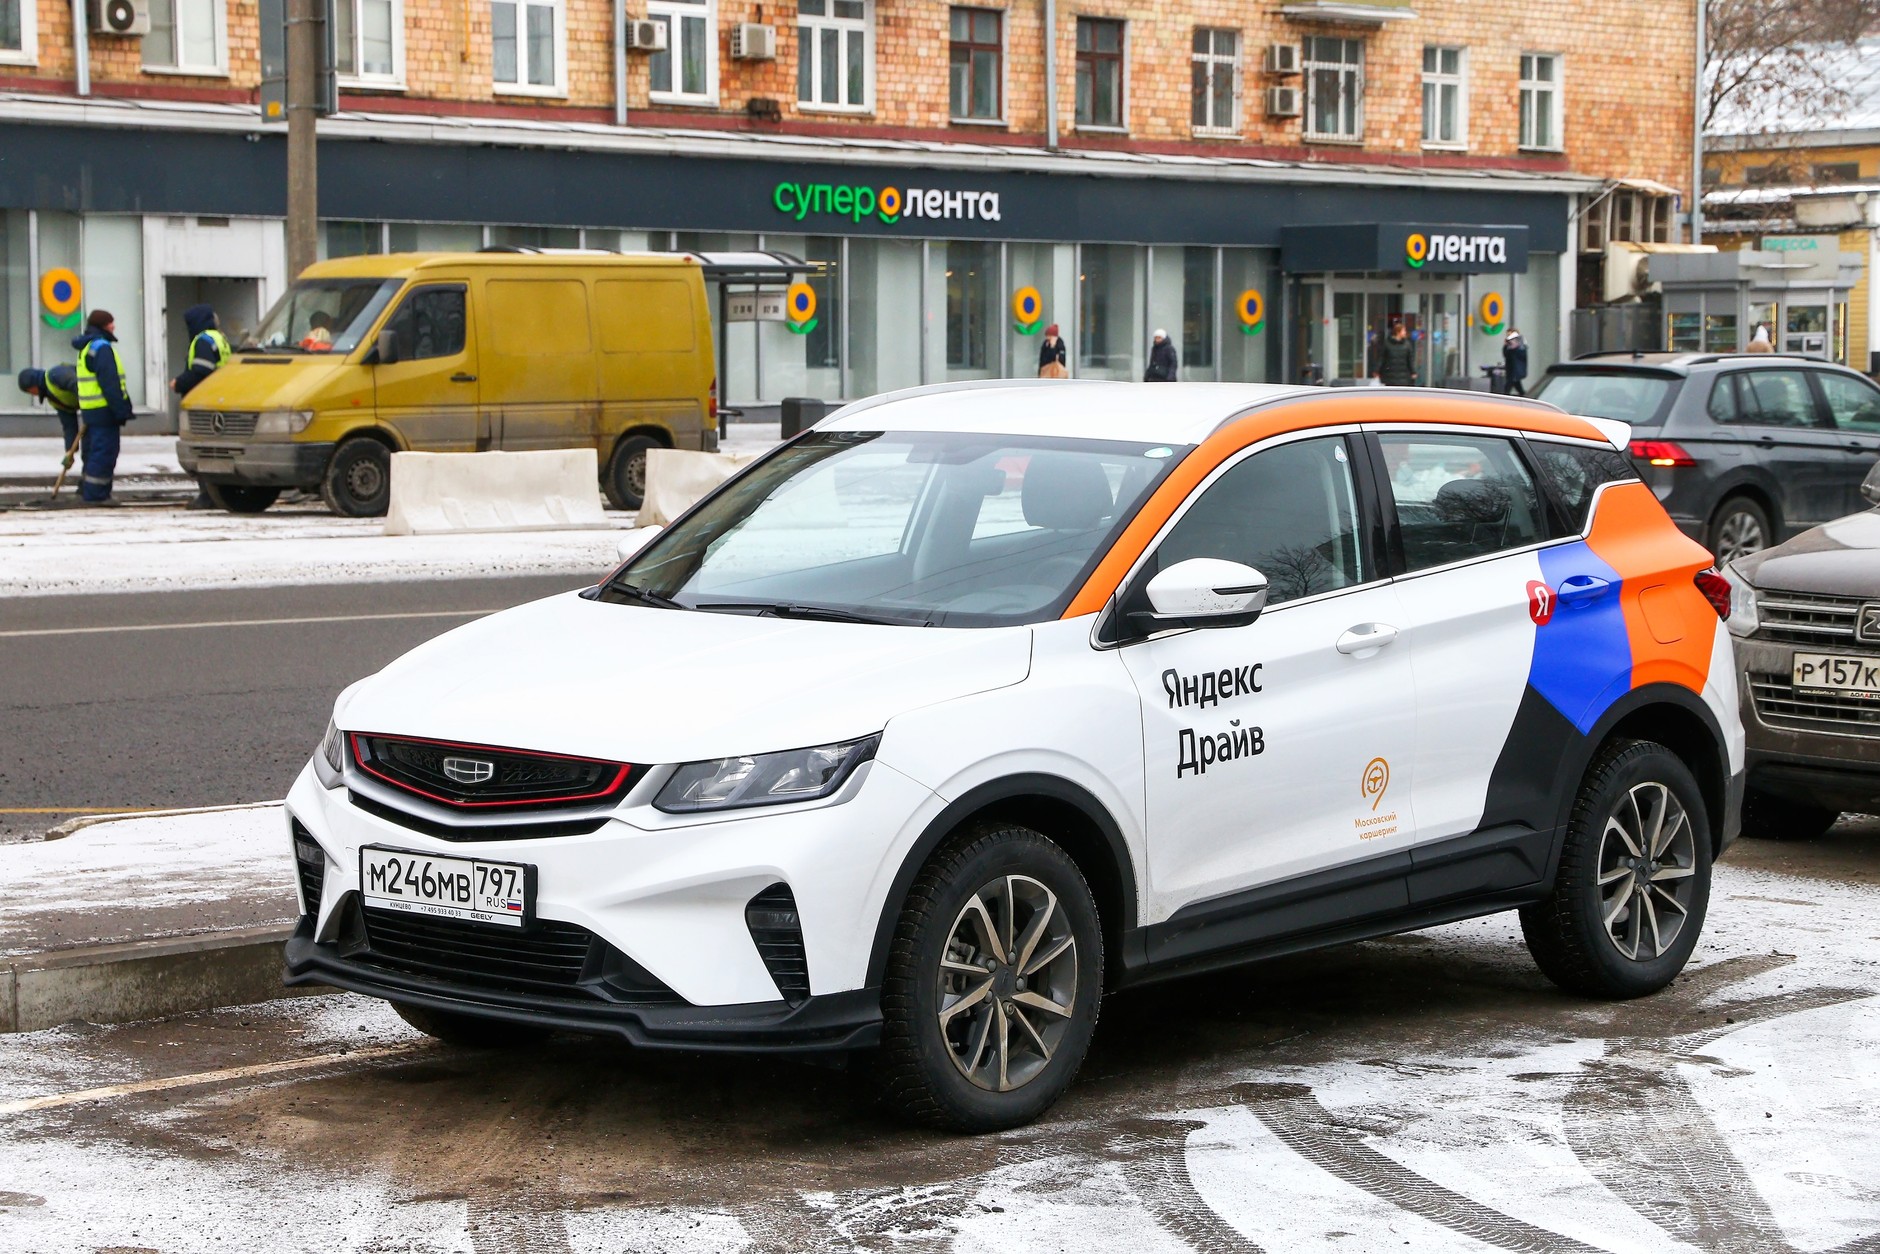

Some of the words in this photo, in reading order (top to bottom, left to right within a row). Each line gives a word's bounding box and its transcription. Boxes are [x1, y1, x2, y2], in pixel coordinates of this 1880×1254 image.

[774, 181, 876, 223] супер
[903, 188, 1001, 221] лента
[1427, 235, 1507, 263] лента
[1534, 586, 1549, 617] Я
[1162, 663, 1263, 709] Яндекс
[1177, 719, 1265, 779] Драйв
[1354, 811, 1397, 828] Московский
[1359, 826, 1397, 841] каршеринг
[370, 857, 471, 902] М246МВ
[476, 866, 517, 897] 797
[389, 902, 412, 910] КУНЦЕВО
[470, 912, 493, 921] GEELY
[486, 897, 507, 909] RUS
